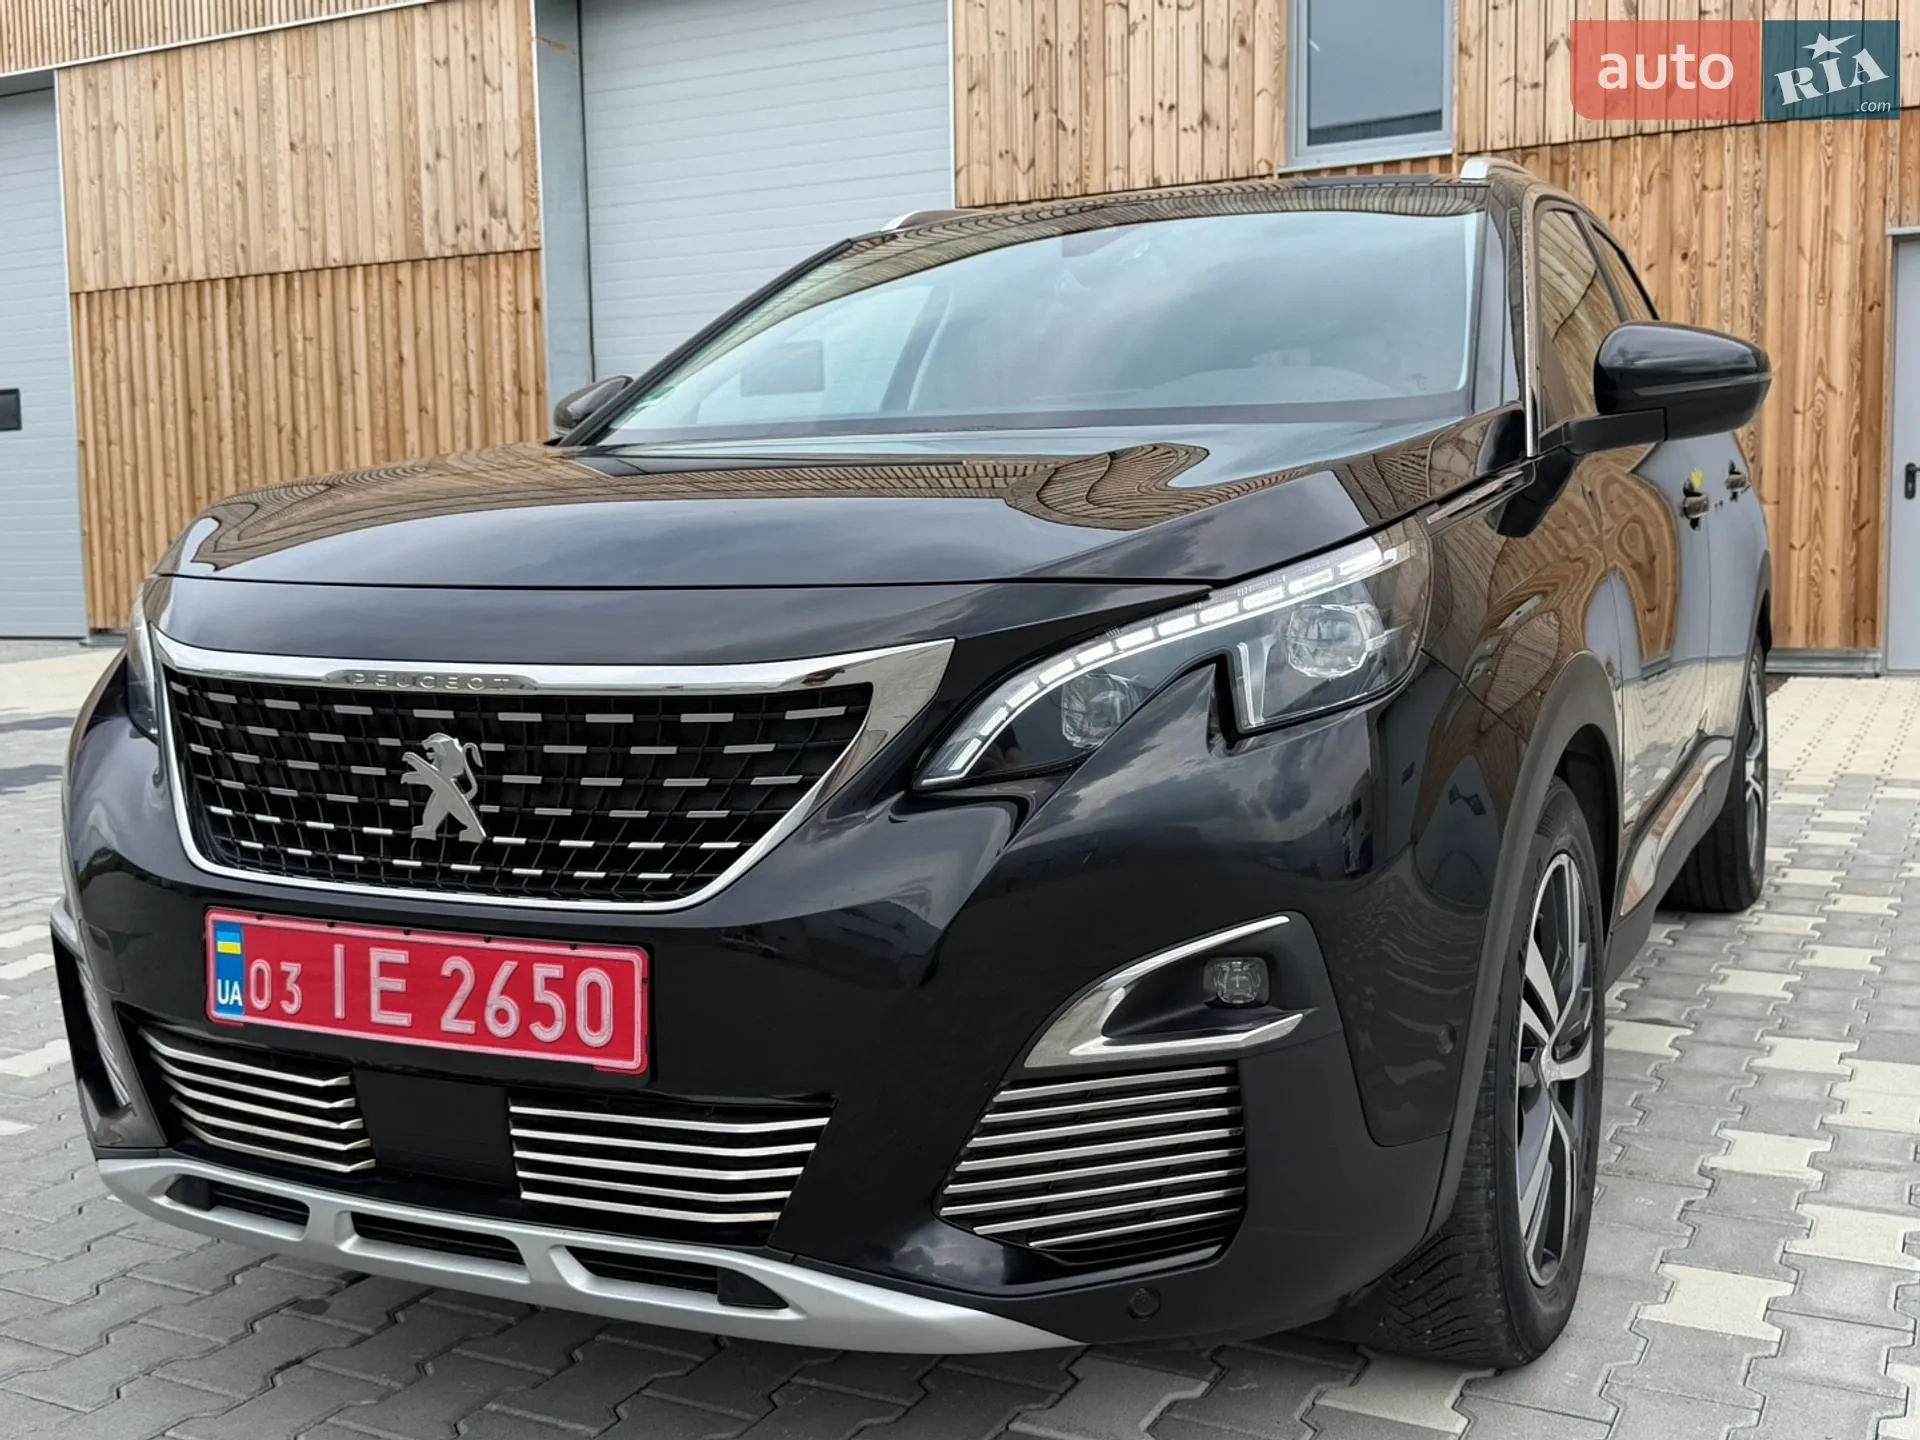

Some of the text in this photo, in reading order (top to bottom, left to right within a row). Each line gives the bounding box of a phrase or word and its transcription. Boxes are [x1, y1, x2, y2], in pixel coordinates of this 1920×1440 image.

[352, 673, 510, 691] PEUGEOT
[217, 978, 243, 1006] UA
[249, 943, 614, 1047] 03 IE 2650
